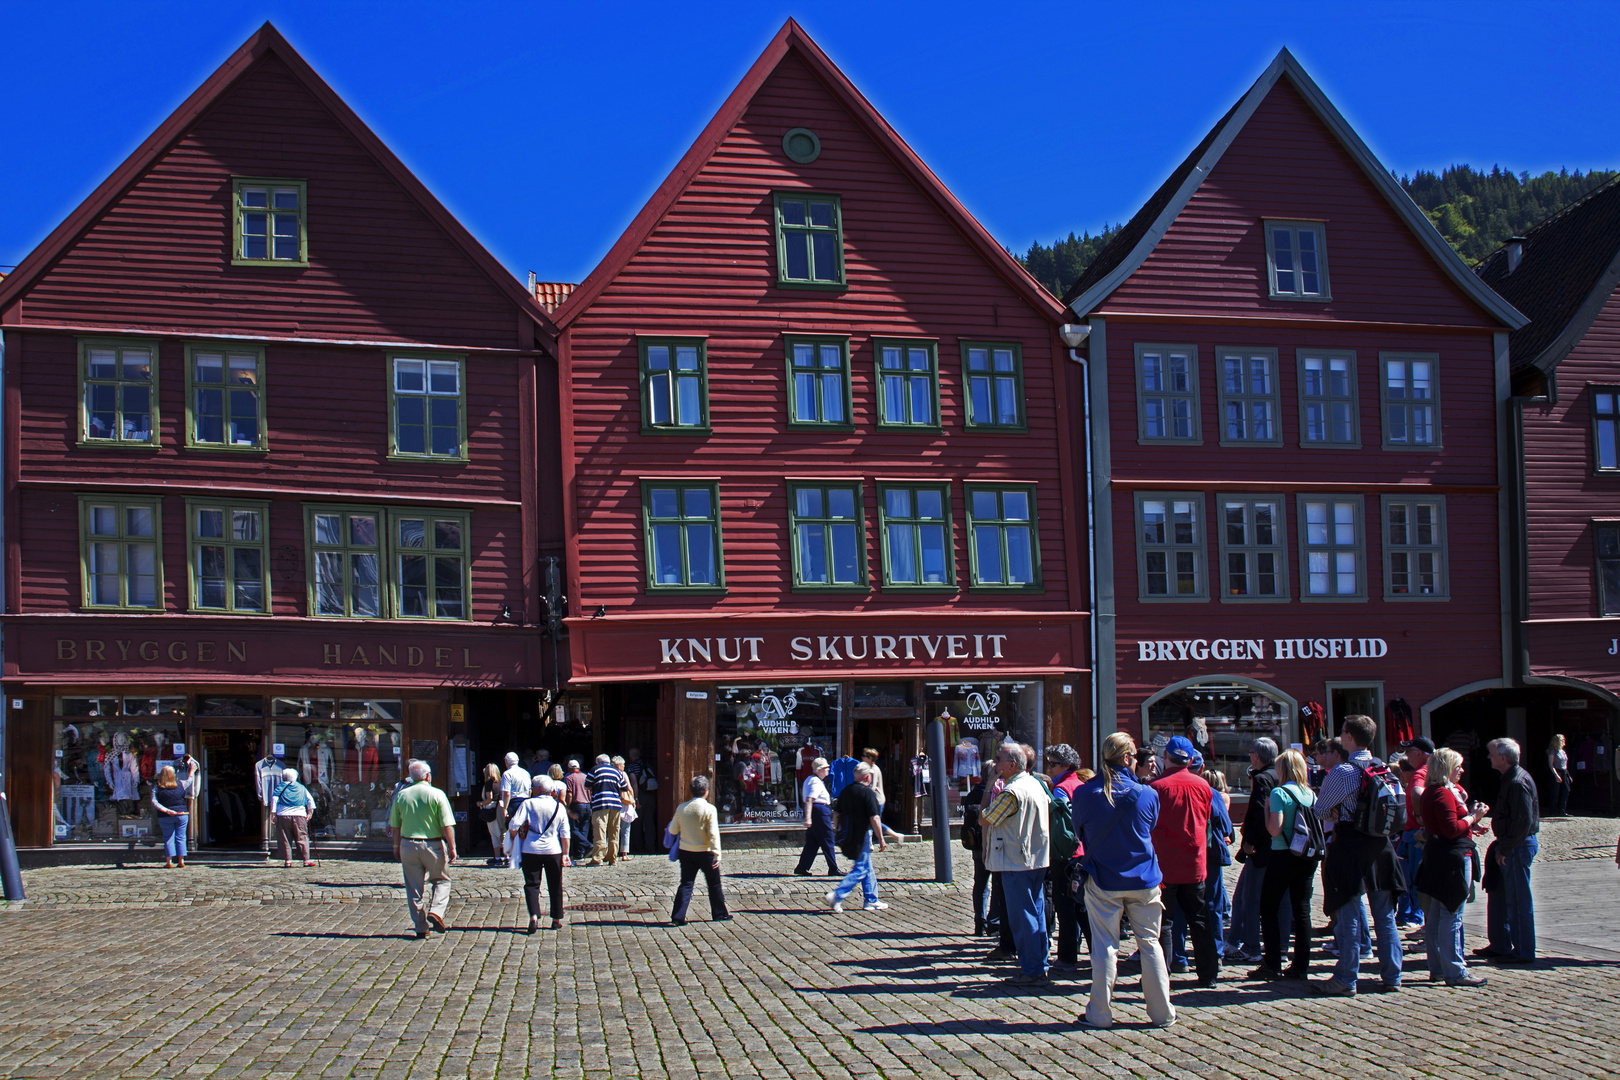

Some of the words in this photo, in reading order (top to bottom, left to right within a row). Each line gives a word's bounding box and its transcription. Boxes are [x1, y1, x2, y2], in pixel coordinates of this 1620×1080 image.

[56, 639, 247, 662] BRYGGEN
[322, 643, 482, 669] HANDEL
[659, 637, 765, 664] KNUT
[790, 634, 1008, 661] SKURTVEIT
[1137, 638, 1265, 662] BRYGGEN
[1273, 638, 1388, 660] HUSFLID
[744, 810, 782, 818] MEMORIES
[782, 810, 789, 818] &
